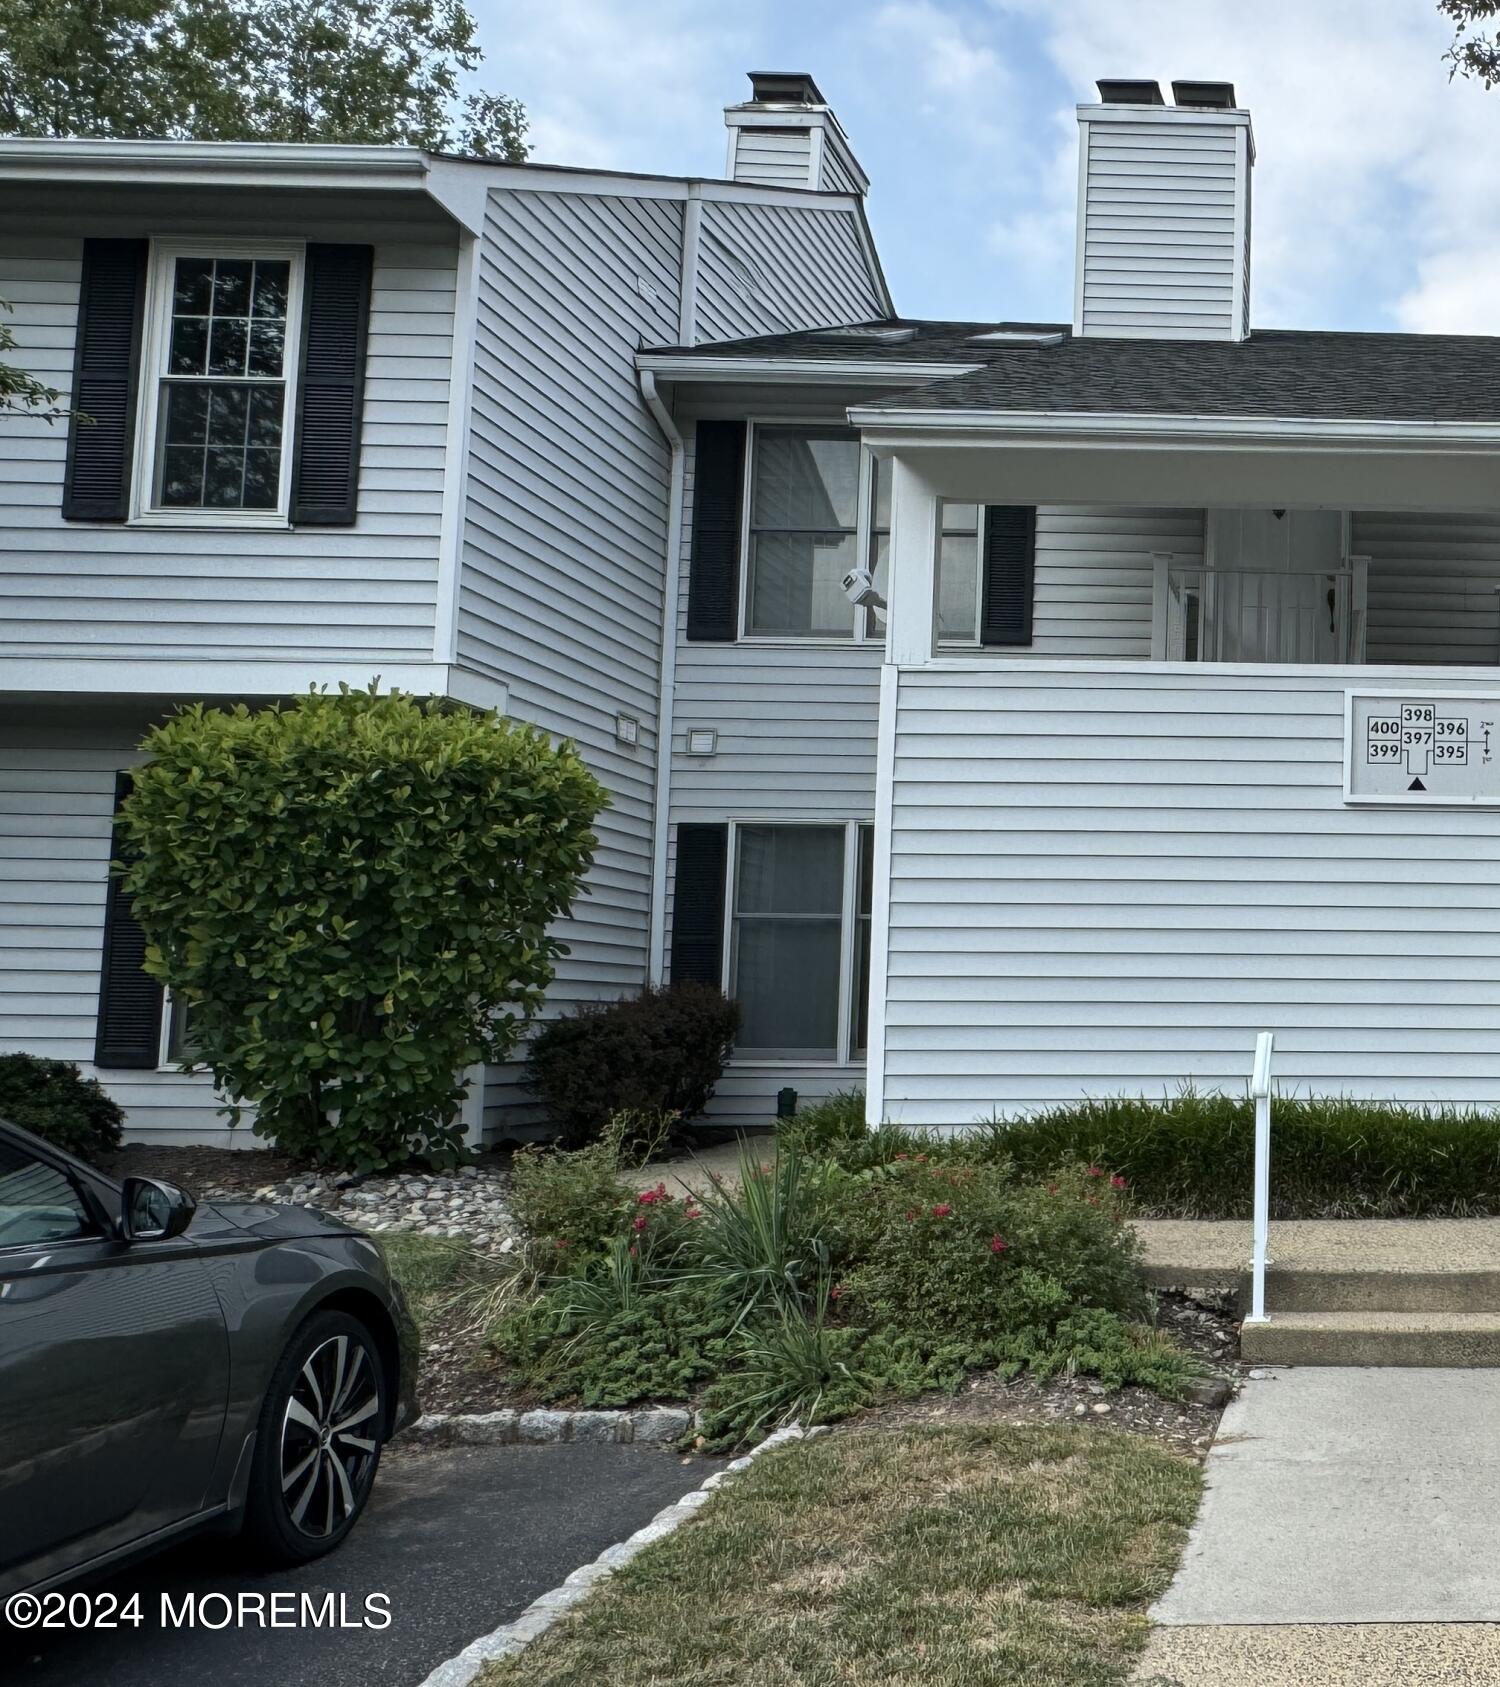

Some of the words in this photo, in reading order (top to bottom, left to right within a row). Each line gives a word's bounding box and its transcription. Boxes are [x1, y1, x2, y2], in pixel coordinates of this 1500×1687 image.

[1404, 709, 1432, 722] 398
[1370, 721, 1399, 734] 400
[1436, 723, 1465, 735] 396
[1403, 732, 1432, 745] 397
[1370, 744, 1399, 757] 399
[1436, 746, 1465, 758] 395
